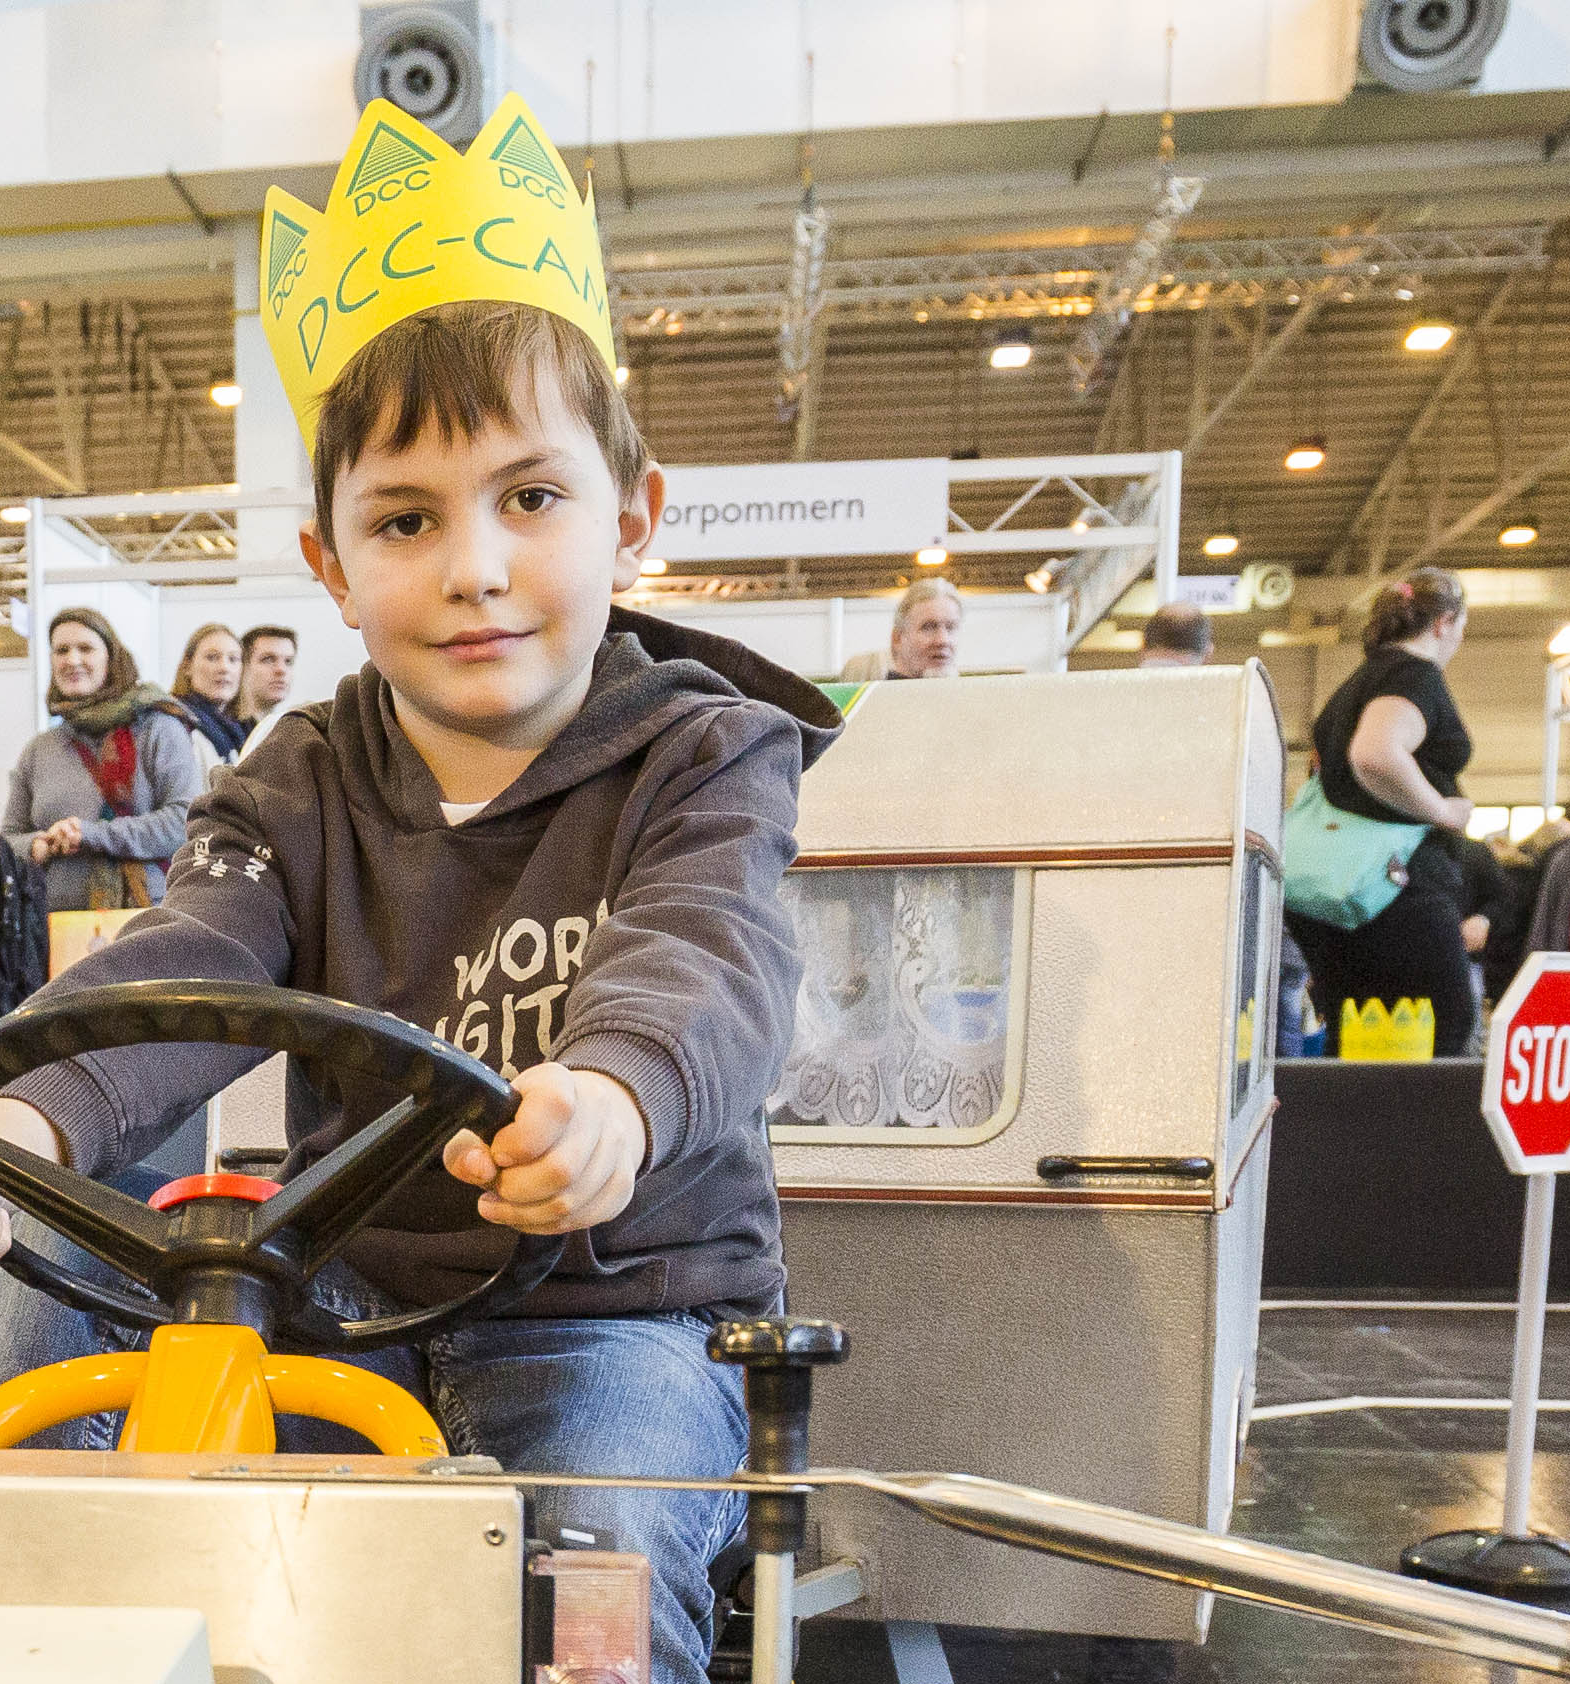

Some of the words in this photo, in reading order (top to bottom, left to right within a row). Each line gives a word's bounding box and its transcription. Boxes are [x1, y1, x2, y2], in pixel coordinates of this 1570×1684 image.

[354, 169, 431, 217] DCC
[498, 167, 566, 210] DCC
[271, 247, 308, 321] DCC
[454, 898, 610, 1000] WOR
